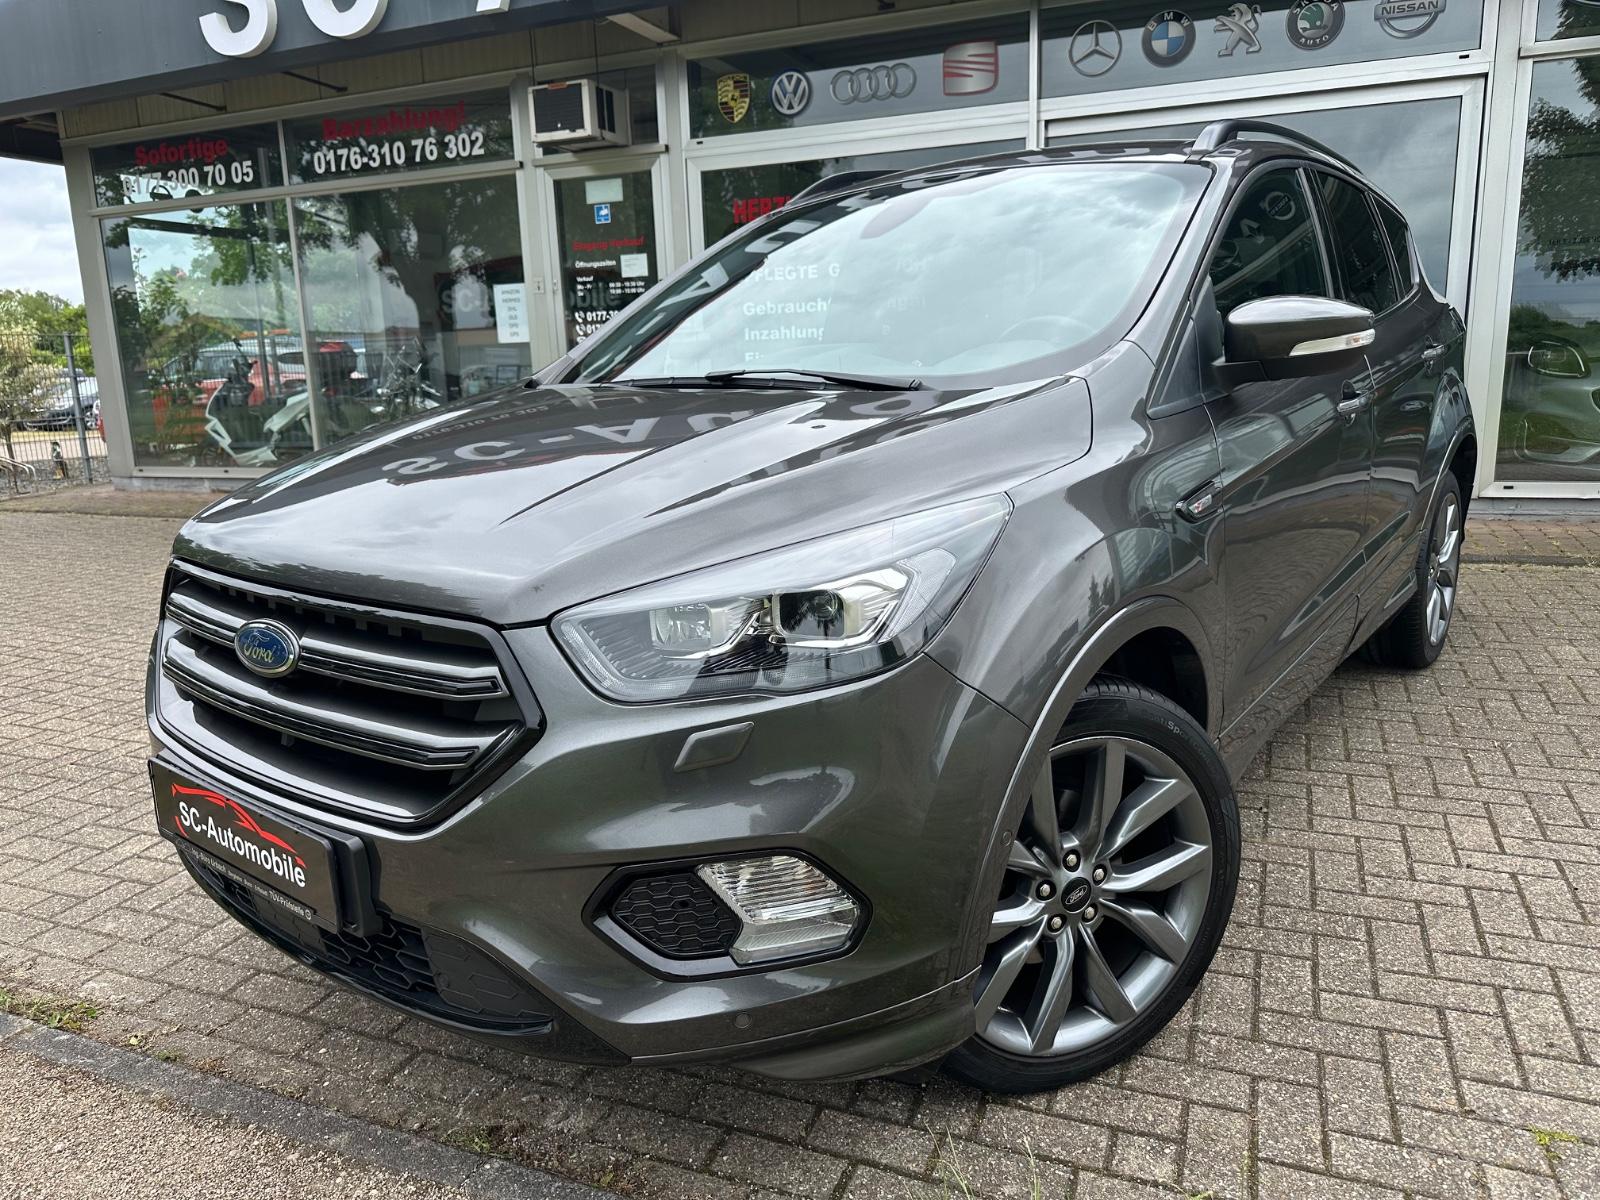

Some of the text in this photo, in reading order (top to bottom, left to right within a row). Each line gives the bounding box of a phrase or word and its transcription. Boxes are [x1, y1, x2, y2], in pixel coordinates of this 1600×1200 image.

[1147, 11, 1190, 31] BMW
[1381, 1, 1439, 15] NISSAN
[1299, 34, 1329, 46] AUTO
[135, 139, 229, 165] Sofortige
[313, 131, 485, 174] 0176-310 76 302
[122, 160, 254, 196] 0177-300 70 05
[586, 311, 620, 322] 0177-3
[243, 629, 278, 663] Ford
[179, 801, 306, 888] SC-Automobile
